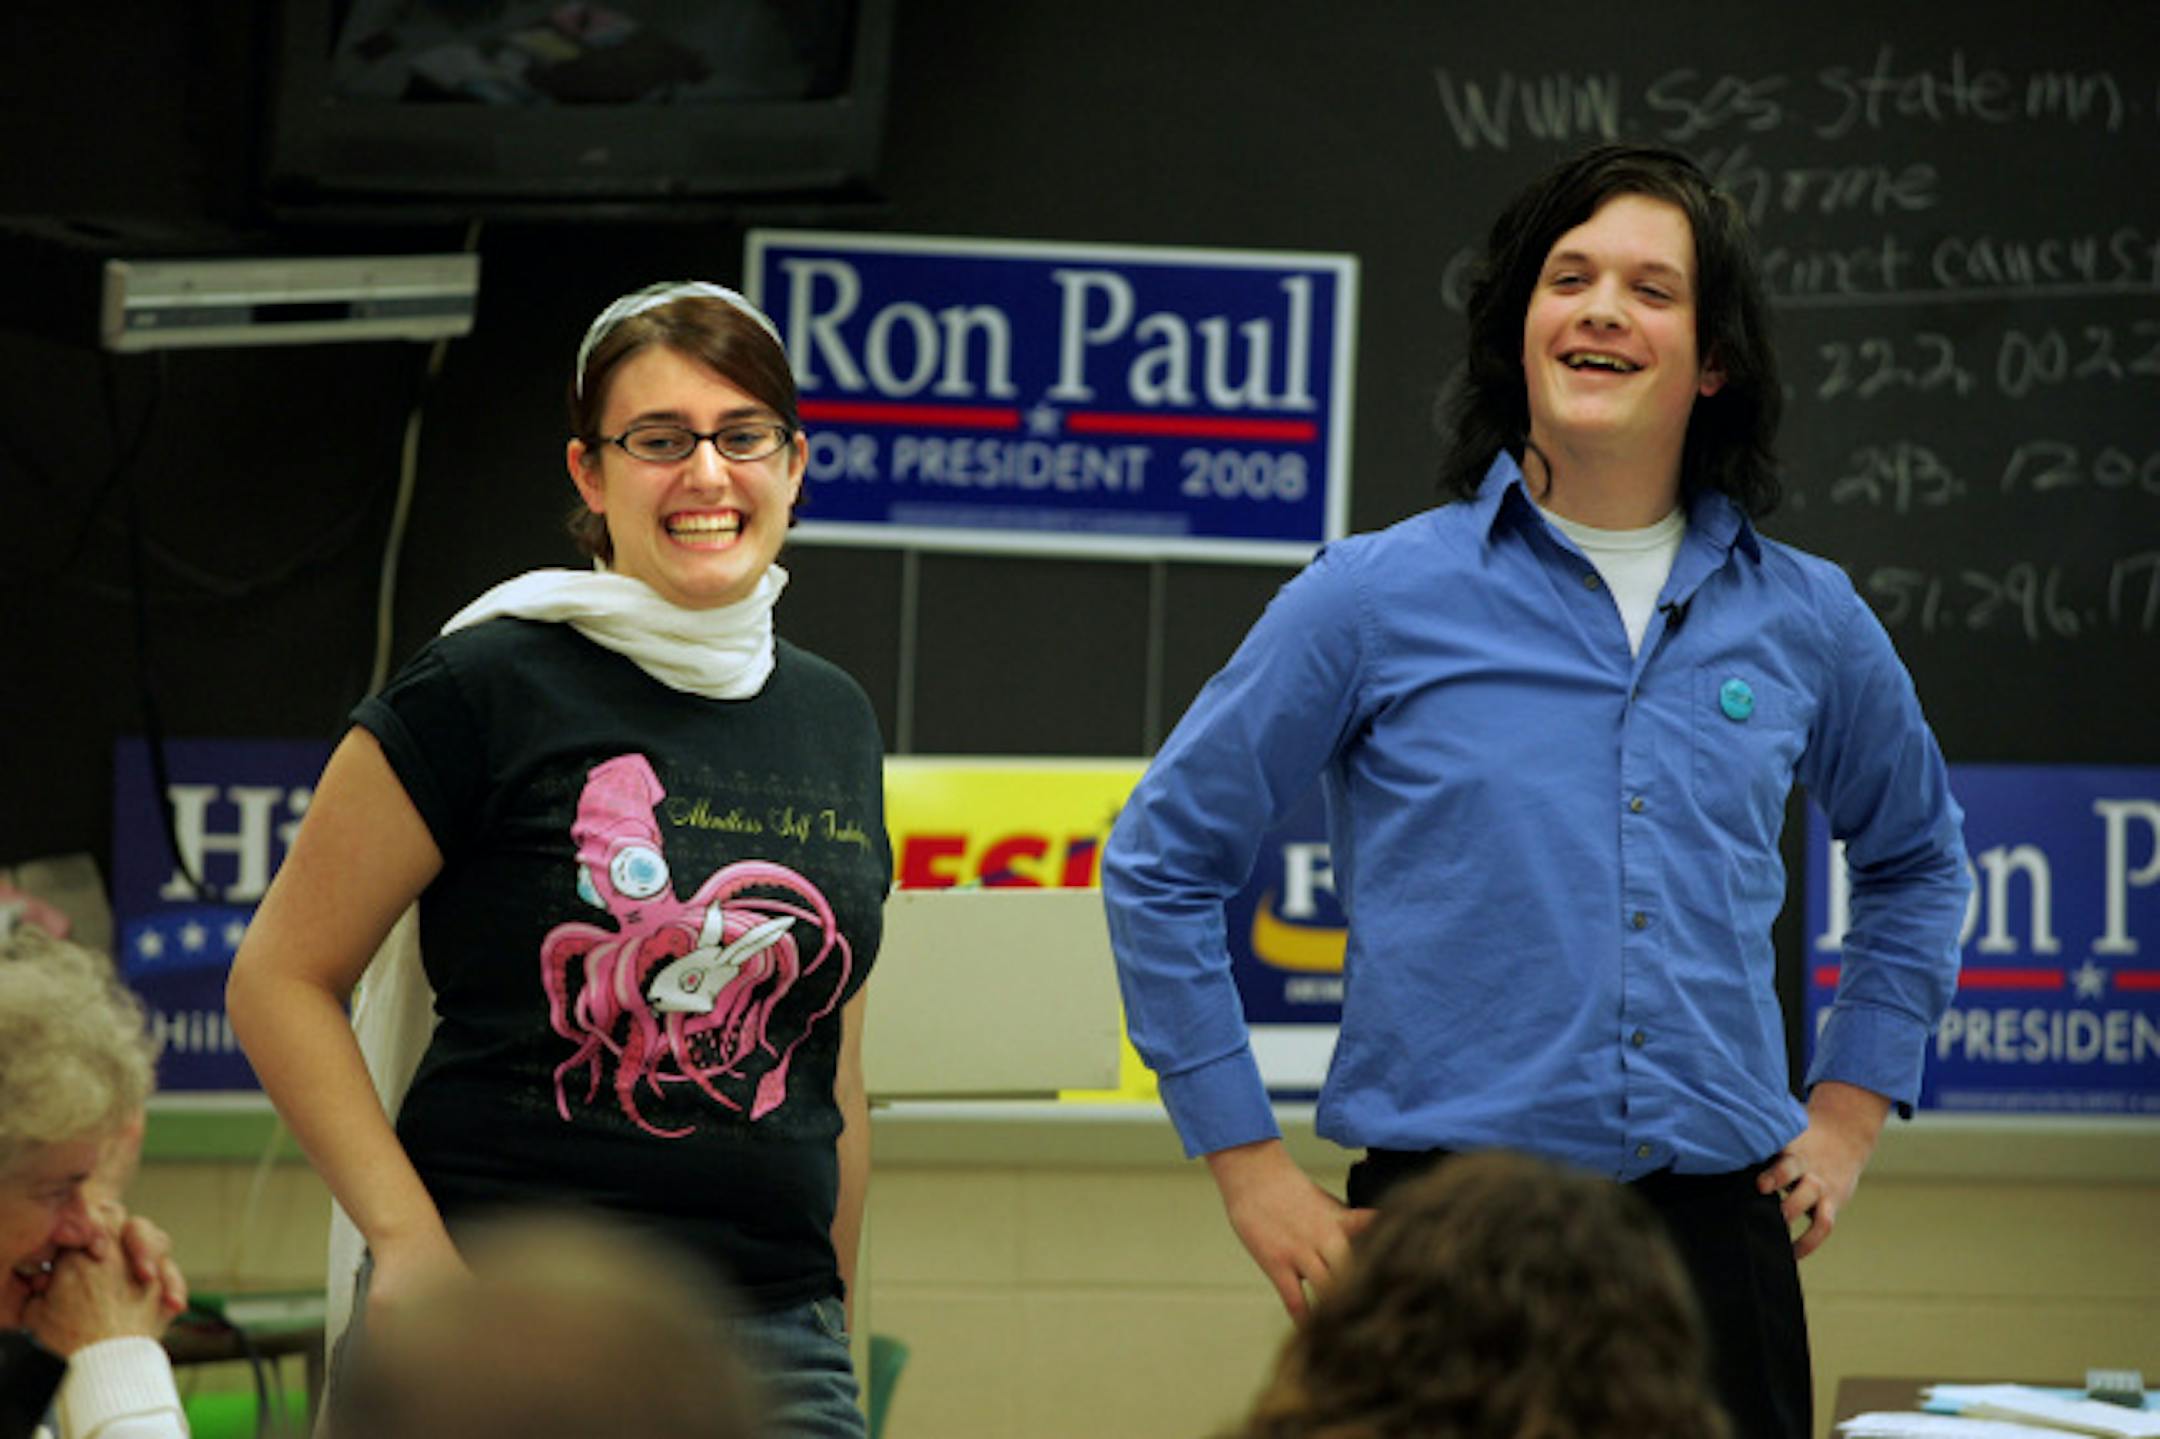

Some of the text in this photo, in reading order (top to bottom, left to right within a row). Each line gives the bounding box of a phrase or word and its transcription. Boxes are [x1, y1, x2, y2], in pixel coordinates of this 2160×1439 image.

[781, 257, 1017, 398] Ron
[1048, 268, 1318, 410] Paul
[808, 432, 1307, 500] OR PRESIDENT 2008
